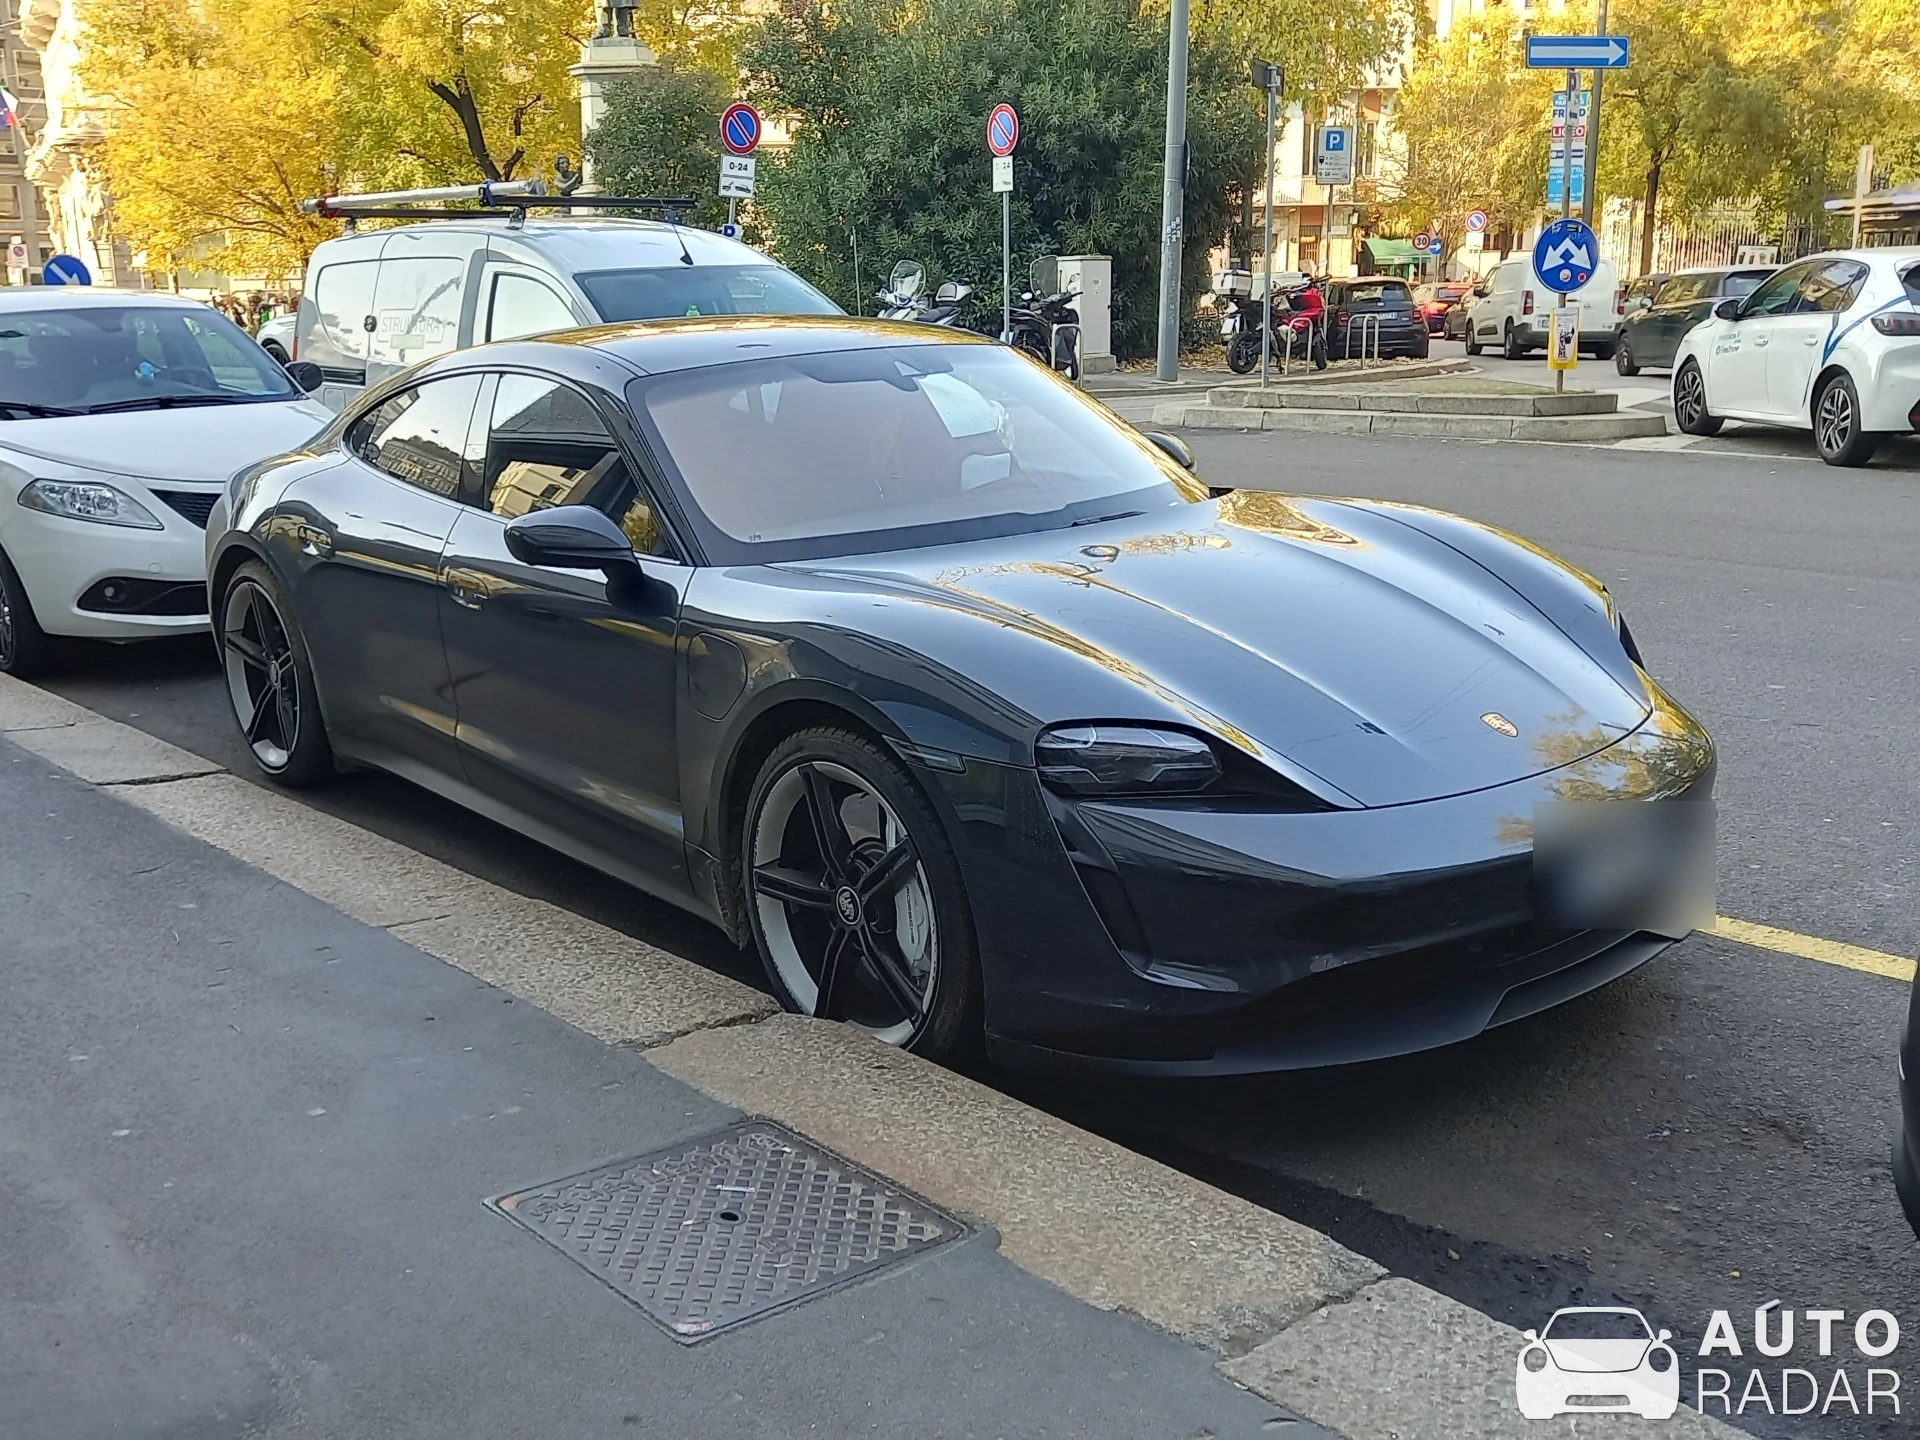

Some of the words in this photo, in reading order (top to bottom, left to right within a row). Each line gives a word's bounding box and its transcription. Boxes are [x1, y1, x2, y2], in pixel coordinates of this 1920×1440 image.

[1329, 133, 1341, 149] P
[729, 161, 749, 172] 0-24
[1416, 237, 1427, 246] 30
[906, 886, 915, 944] PORSCHE
